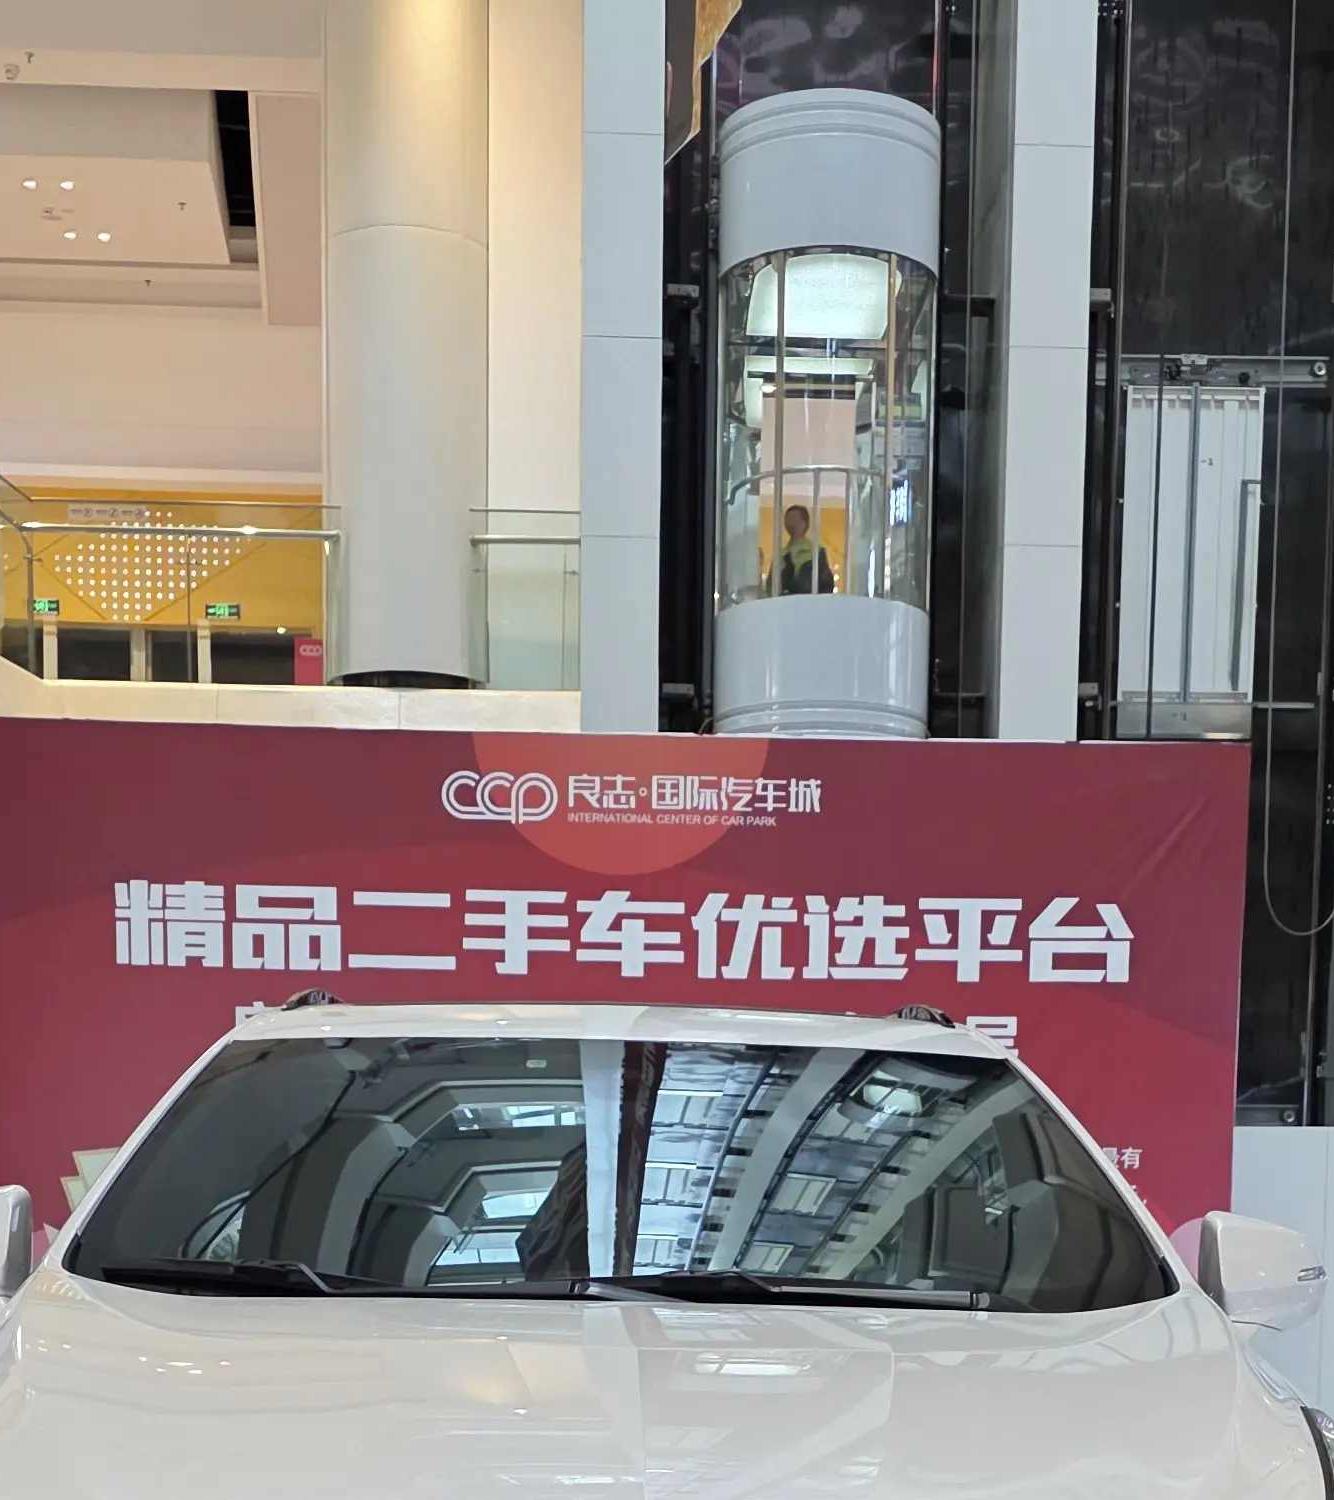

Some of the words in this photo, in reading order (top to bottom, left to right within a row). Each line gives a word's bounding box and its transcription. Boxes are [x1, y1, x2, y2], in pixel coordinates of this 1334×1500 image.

[567, 812, 653, 825] INTERNATIONAL
[656, 814, 701, 825] CENTER
[703, 815, 719, 825] OF
[720, 815, 744, 826] CAR
[746, 815, 777, 827] PARK
[114, 879, 1135, 983] 精品二手车优选平台
